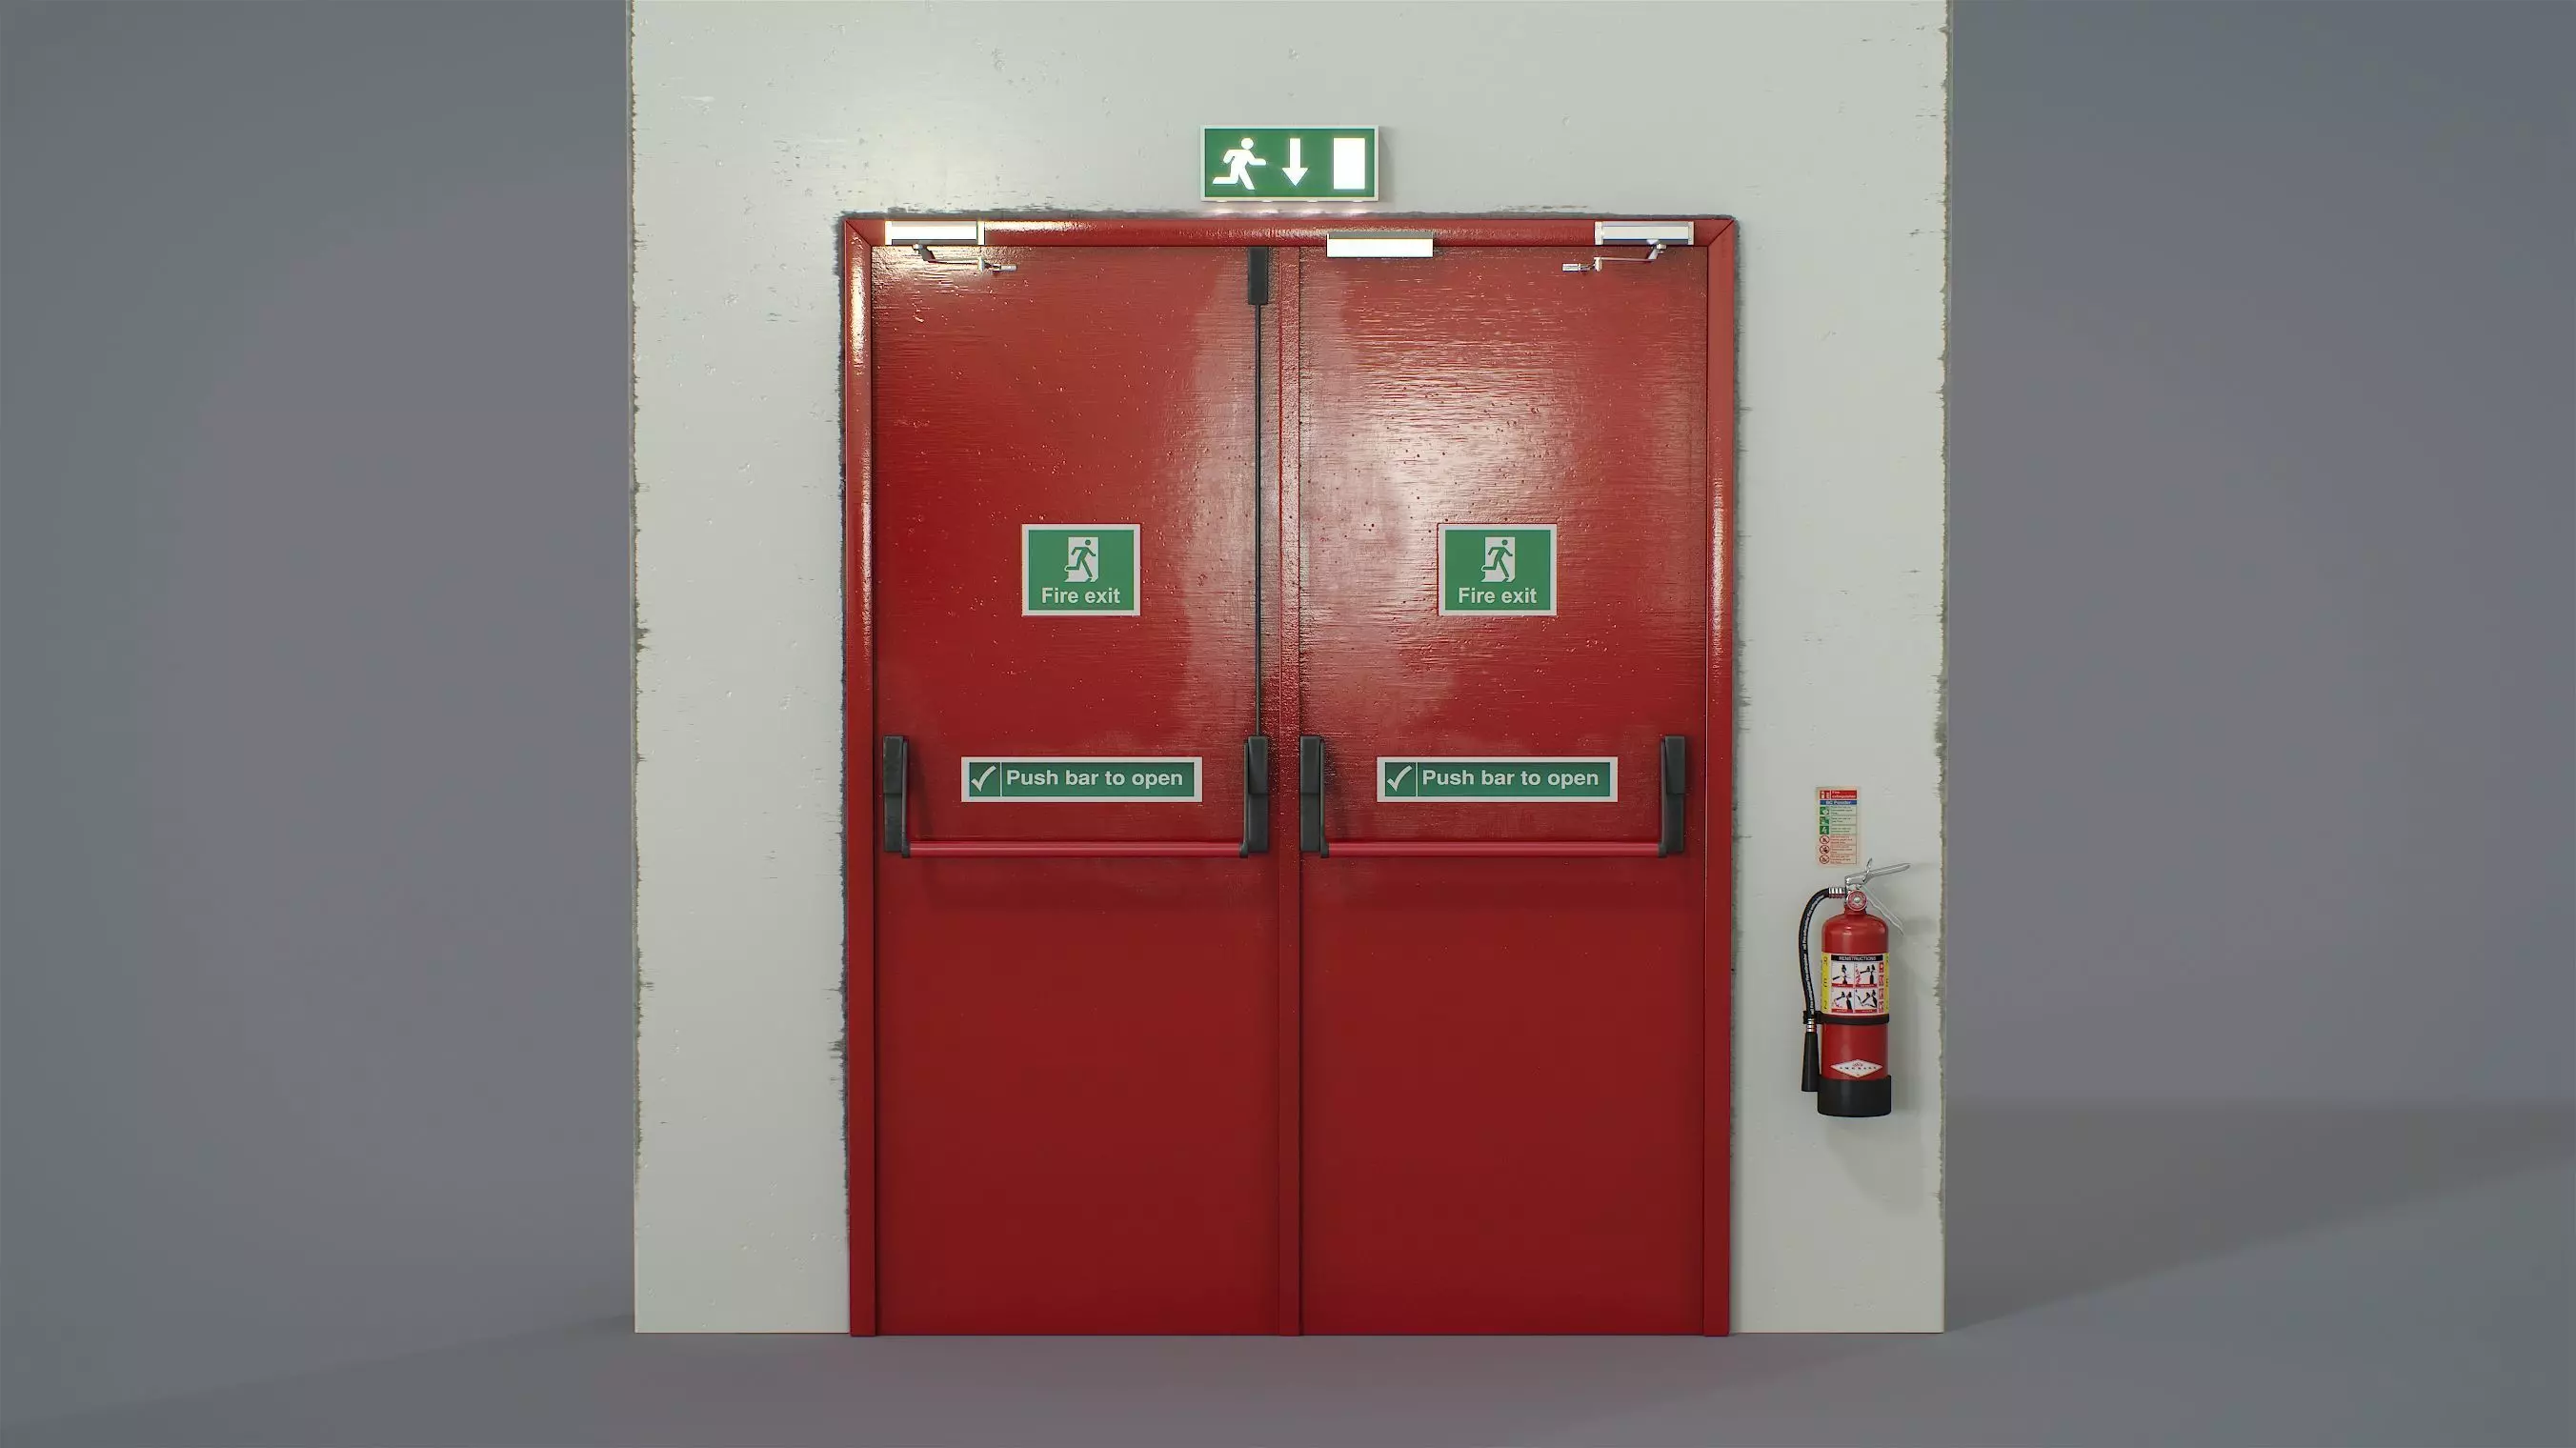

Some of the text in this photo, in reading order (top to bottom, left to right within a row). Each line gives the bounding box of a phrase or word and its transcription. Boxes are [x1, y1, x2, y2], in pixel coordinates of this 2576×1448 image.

[1041, 587, 1120, 603] Fire exit
[1459, 587, 1537, 603] Fire exit
[1006, 770, 1183, 789] Push bar to open
[1422, 770, 1599, 789] Push bar to open
